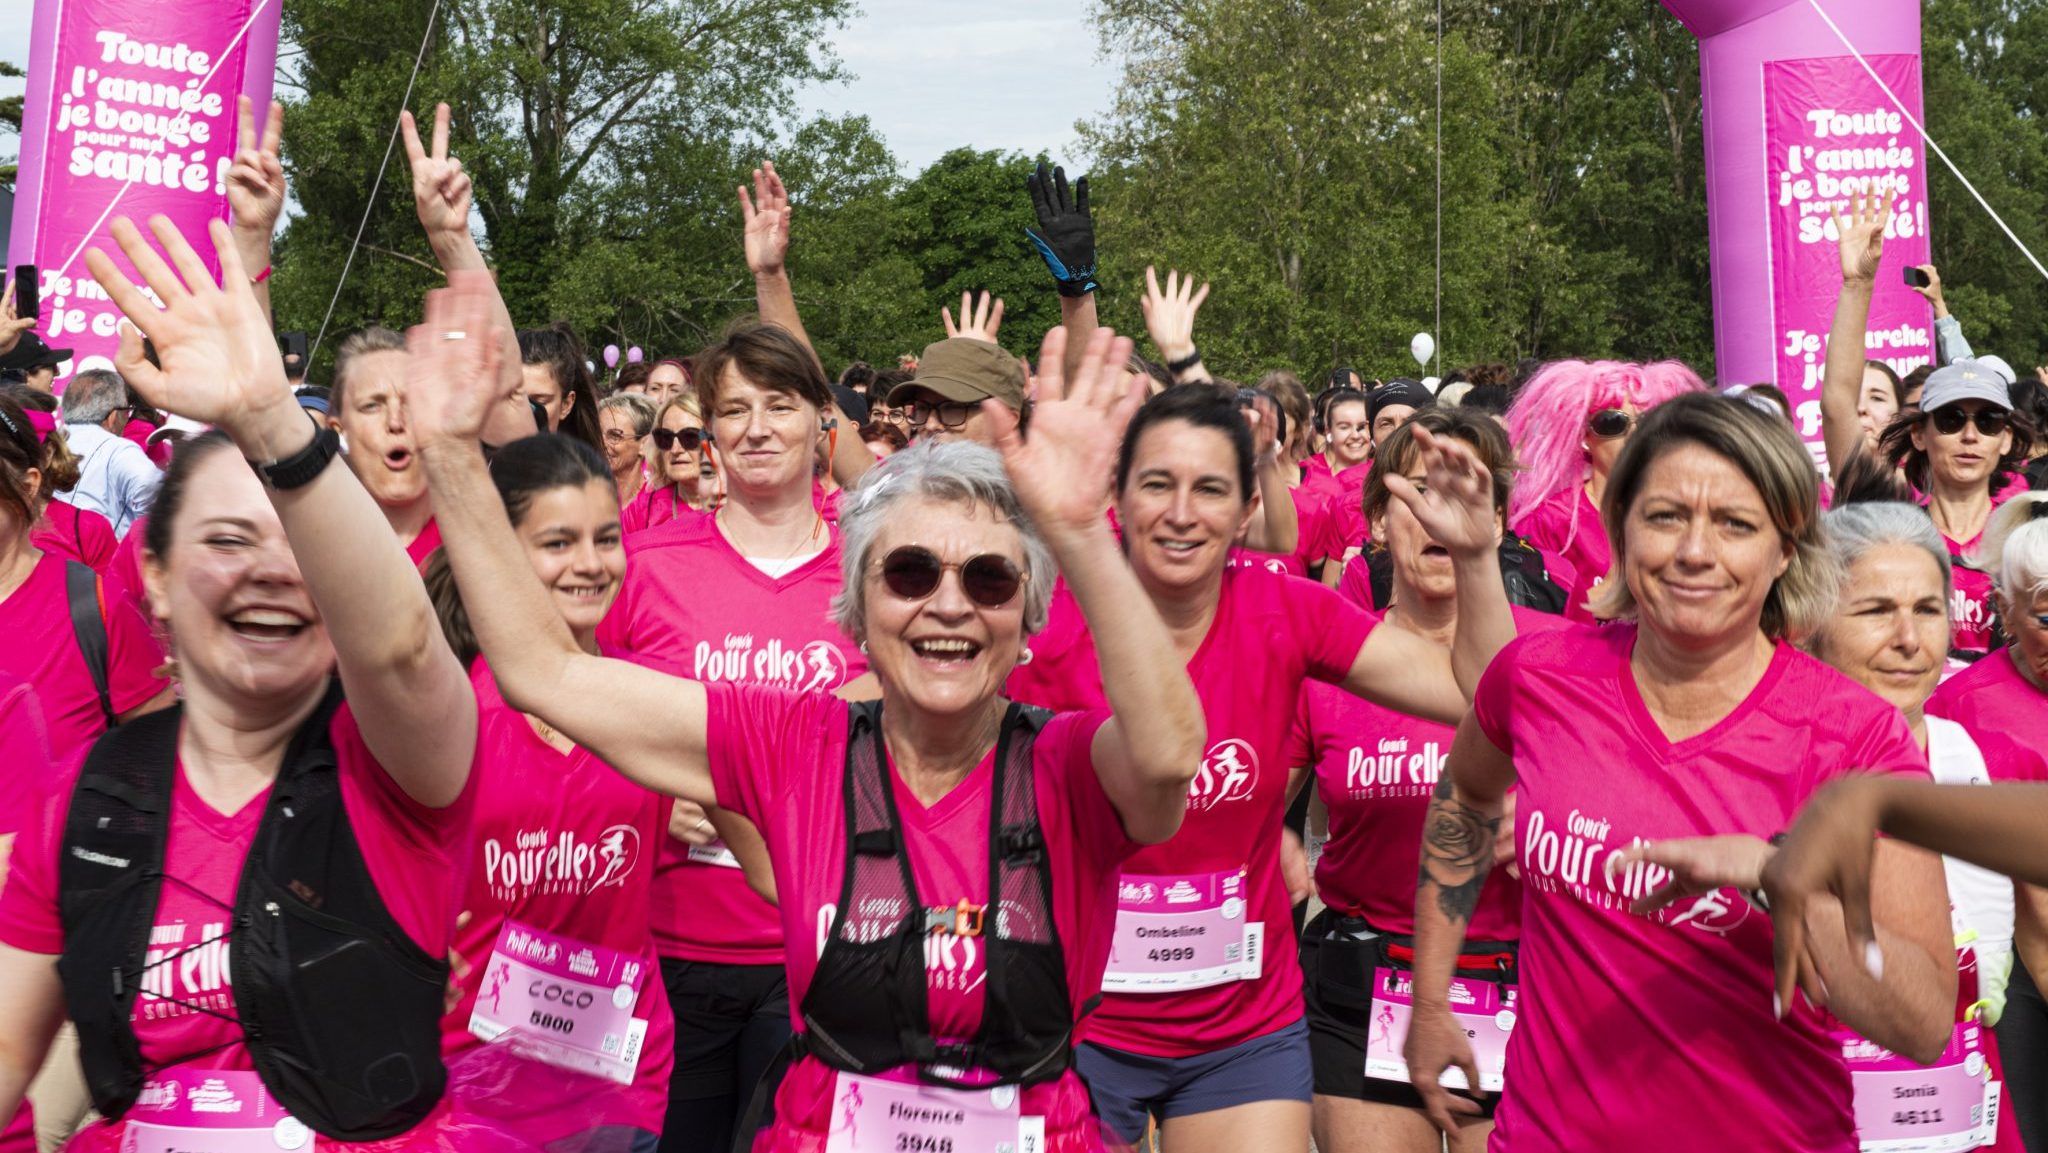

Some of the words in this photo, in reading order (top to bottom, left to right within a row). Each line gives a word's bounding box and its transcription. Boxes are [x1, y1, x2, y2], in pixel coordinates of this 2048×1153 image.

[96, 30, 210, 75] Toute
[71, 66, 222, 116] l'année
[57, 93, 91, 131] je
[95, 101, 210, 148] bouge
[1806, 107, 1902, 138] Toute
[74, 130, 126, 147] pour
[130, 136, 165, 153] ma
[1788, 137, 1914, 174] l'année
[1779, 171, 1813, 207] je
[1815, 170, 1910, 201] bouge
[39, 270, 72, 297] Je
[47, 296, 87, 338] je
[1785, 330, 1821, 356] Je
[695, 641, 752, 682] Pour
[754, 639, 806, 682] elles
[1347, 746, 1407, 788] Pour
[516, 826, 548, 849] Courir
[1567, 809, 1611, 842] Courir
[485, 839, 546, 888] Pour
[545, 831, 598, 881] elles
[1524, 810, 1604, 885] Pour
[1528, 871, 1557, 894] TOUS
[1135, 925, 1206, 939] Ombeline
[1148, 947, 1195, 962] 4999
[528, 980, 594, 1009] COCO
[530, 1010, 575, 1035] 5800
[1892, 1084, 1938, 1099] Sonia
[889, 1101, 965, 1124] Florence
[1891, 1109, 1944, 1125] 4611
